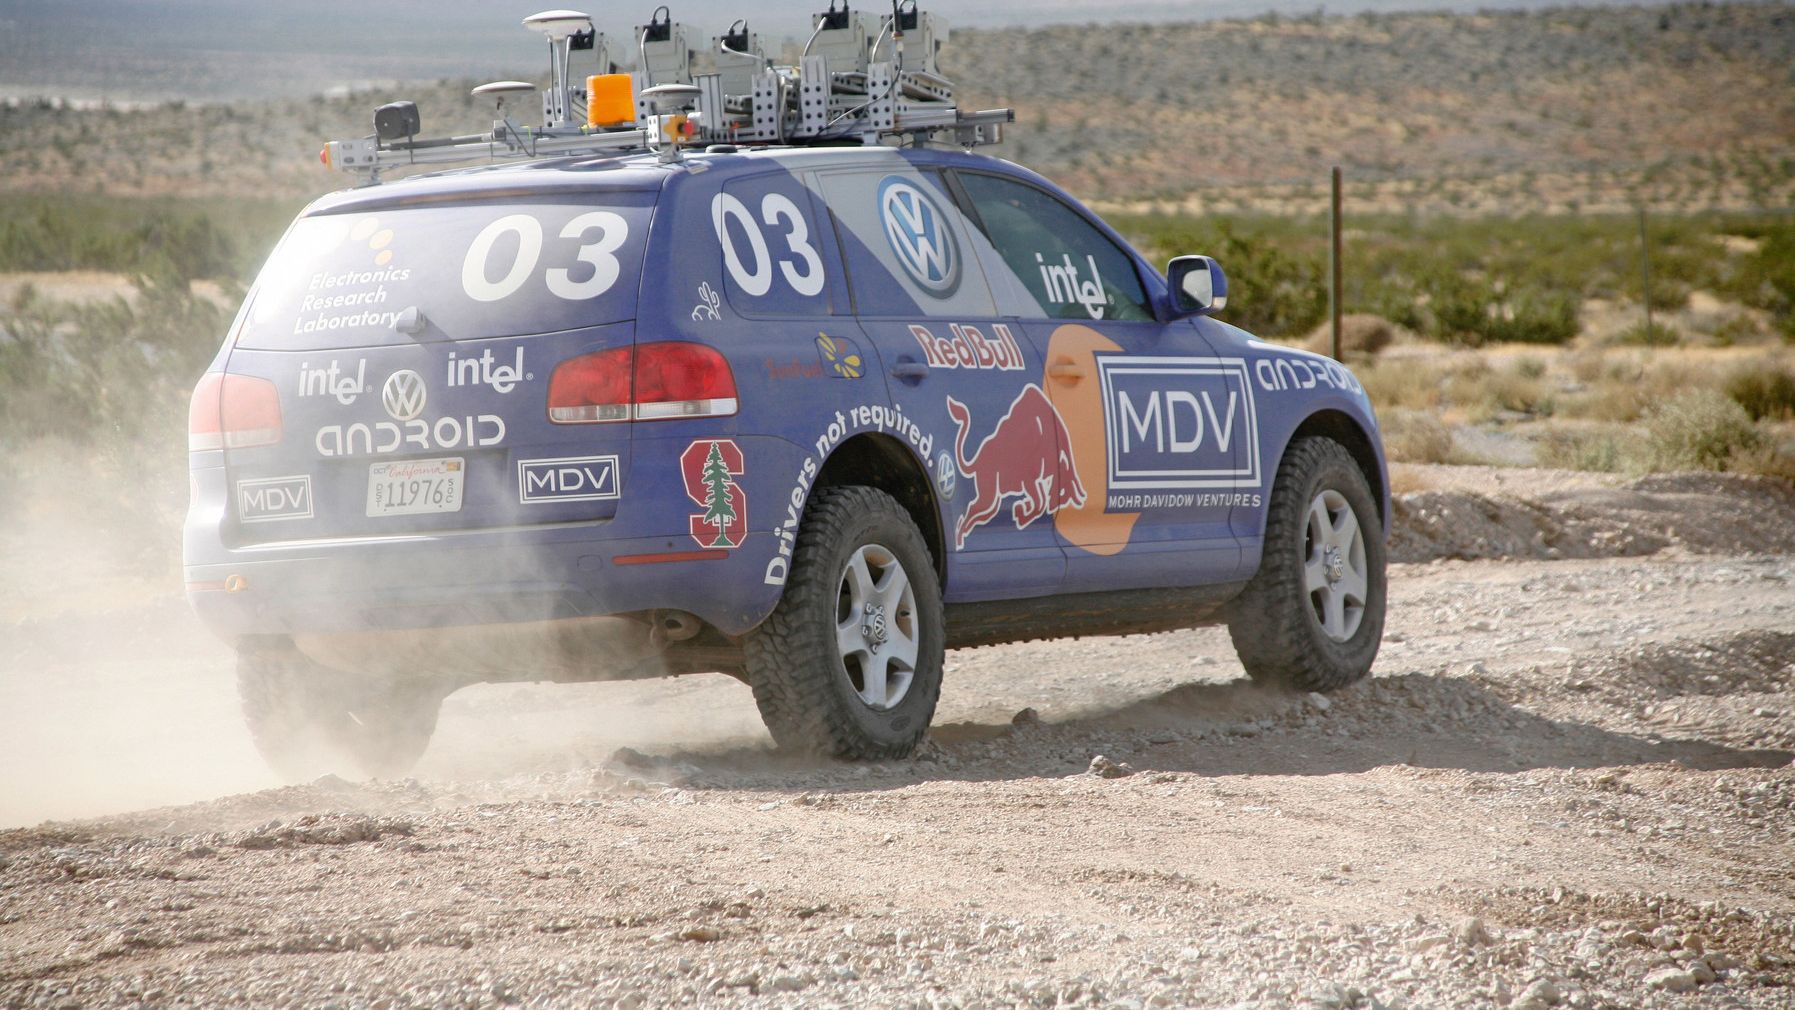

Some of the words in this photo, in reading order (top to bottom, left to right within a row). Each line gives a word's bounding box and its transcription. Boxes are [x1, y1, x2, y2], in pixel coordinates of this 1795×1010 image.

[461, 211, 629, 302] 03
[711, 192, 825, 296] 03
[308, 264, 411, 291] Electronics
[300, 285, 387, 313] Research
[294, 311, 402, 335] Laboratory
[907, 323, 978, 369] Red
[960, 323, 1026, 371] Bull
[1118, 390, 1237, 453] MDV
[387, 462, 446, 480] California
[525, 466, 610, 493] MDV
[243, 486, 304, 512] MDV
[385, 479, 444, 508] 11976
[764, 457, 816, 585] Drivers
[816, 410, 847, 458] not
[850, 404, 934, 468] required.
[1109, 495, 1141, 508] MOHR
[1143, 494, 1194, 508] DAVIDOW
[1197, 493, 1261, 508] VENTURES
